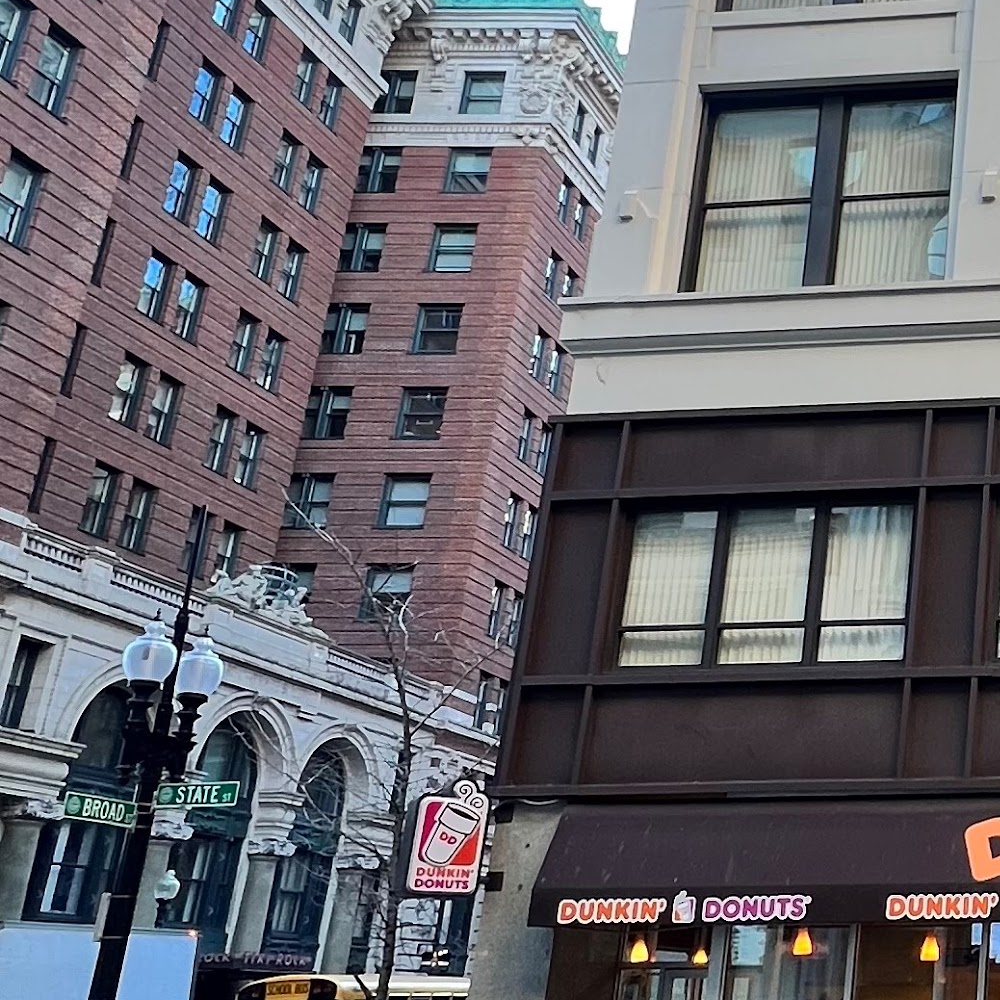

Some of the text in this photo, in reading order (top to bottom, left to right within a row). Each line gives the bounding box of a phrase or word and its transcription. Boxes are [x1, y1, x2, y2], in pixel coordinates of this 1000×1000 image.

[176, 785, 232, 804] STATE ST
[82, 798, 125, 822] BROAD
[439, 831, 457, 845] DD
[414, 879, 469, 890] DONUTS
[558, 896, 808, 922] DUNKIN' DONUTS
[887, 894, 998, 918] DUNKIN'
